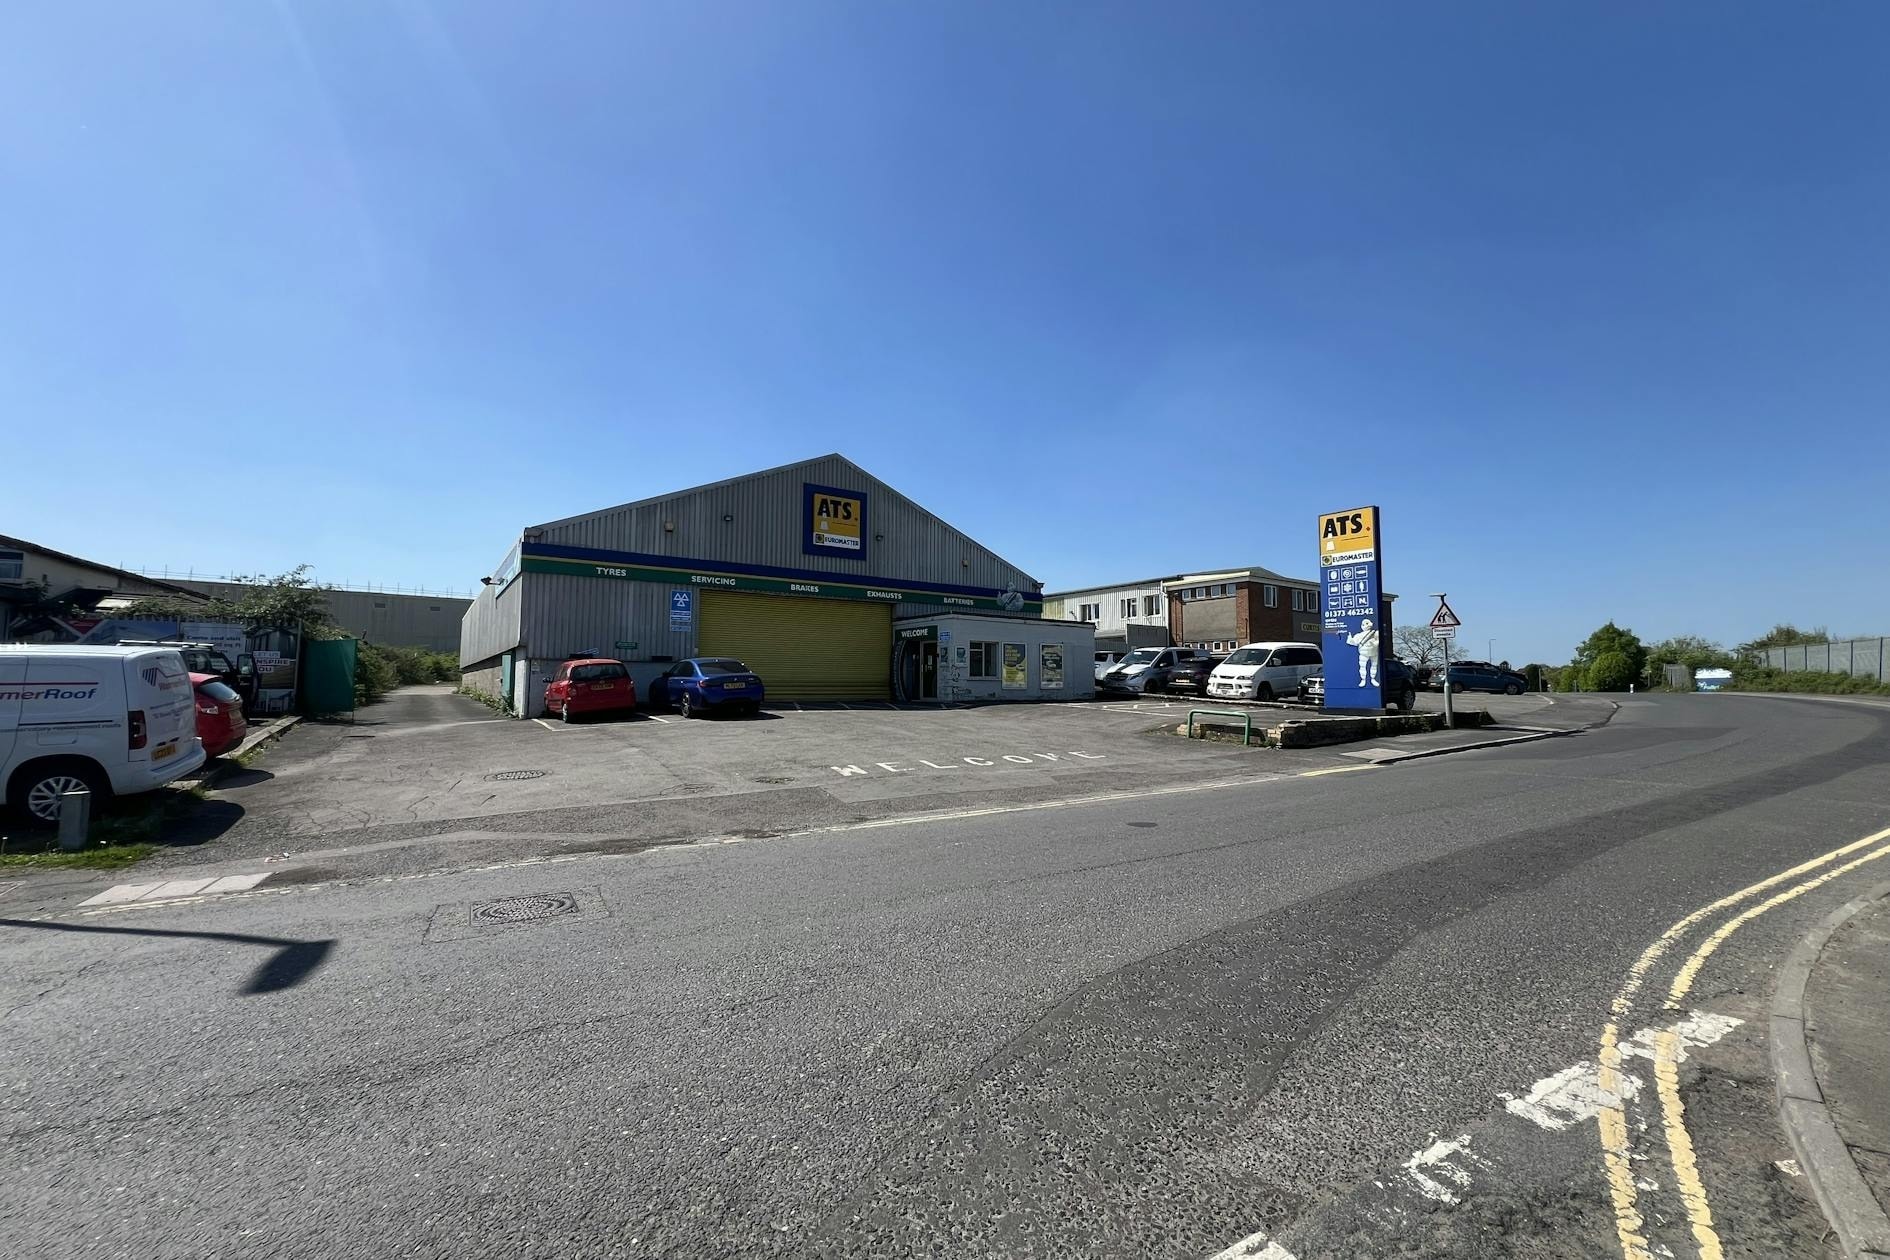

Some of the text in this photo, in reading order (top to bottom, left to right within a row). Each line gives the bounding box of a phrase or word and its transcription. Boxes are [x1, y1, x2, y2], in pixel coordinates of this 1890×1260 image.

[824, 536, 860, 547] EUROMASTER
[1332, 551, 1374, 563] EUROMASTER
[596, 566, 627, 577] TYRES
[691, 575, 736, 586] SERVICING
[790, 583, 819, 593] BRAKES
[866, 590, 903, 600] EXHAUSTS
[943, 596, 974, 606] BATTERIES
[1324, 607, 1374, 618] 01373 462342
[901, 628, 929, 638] WELCOME
